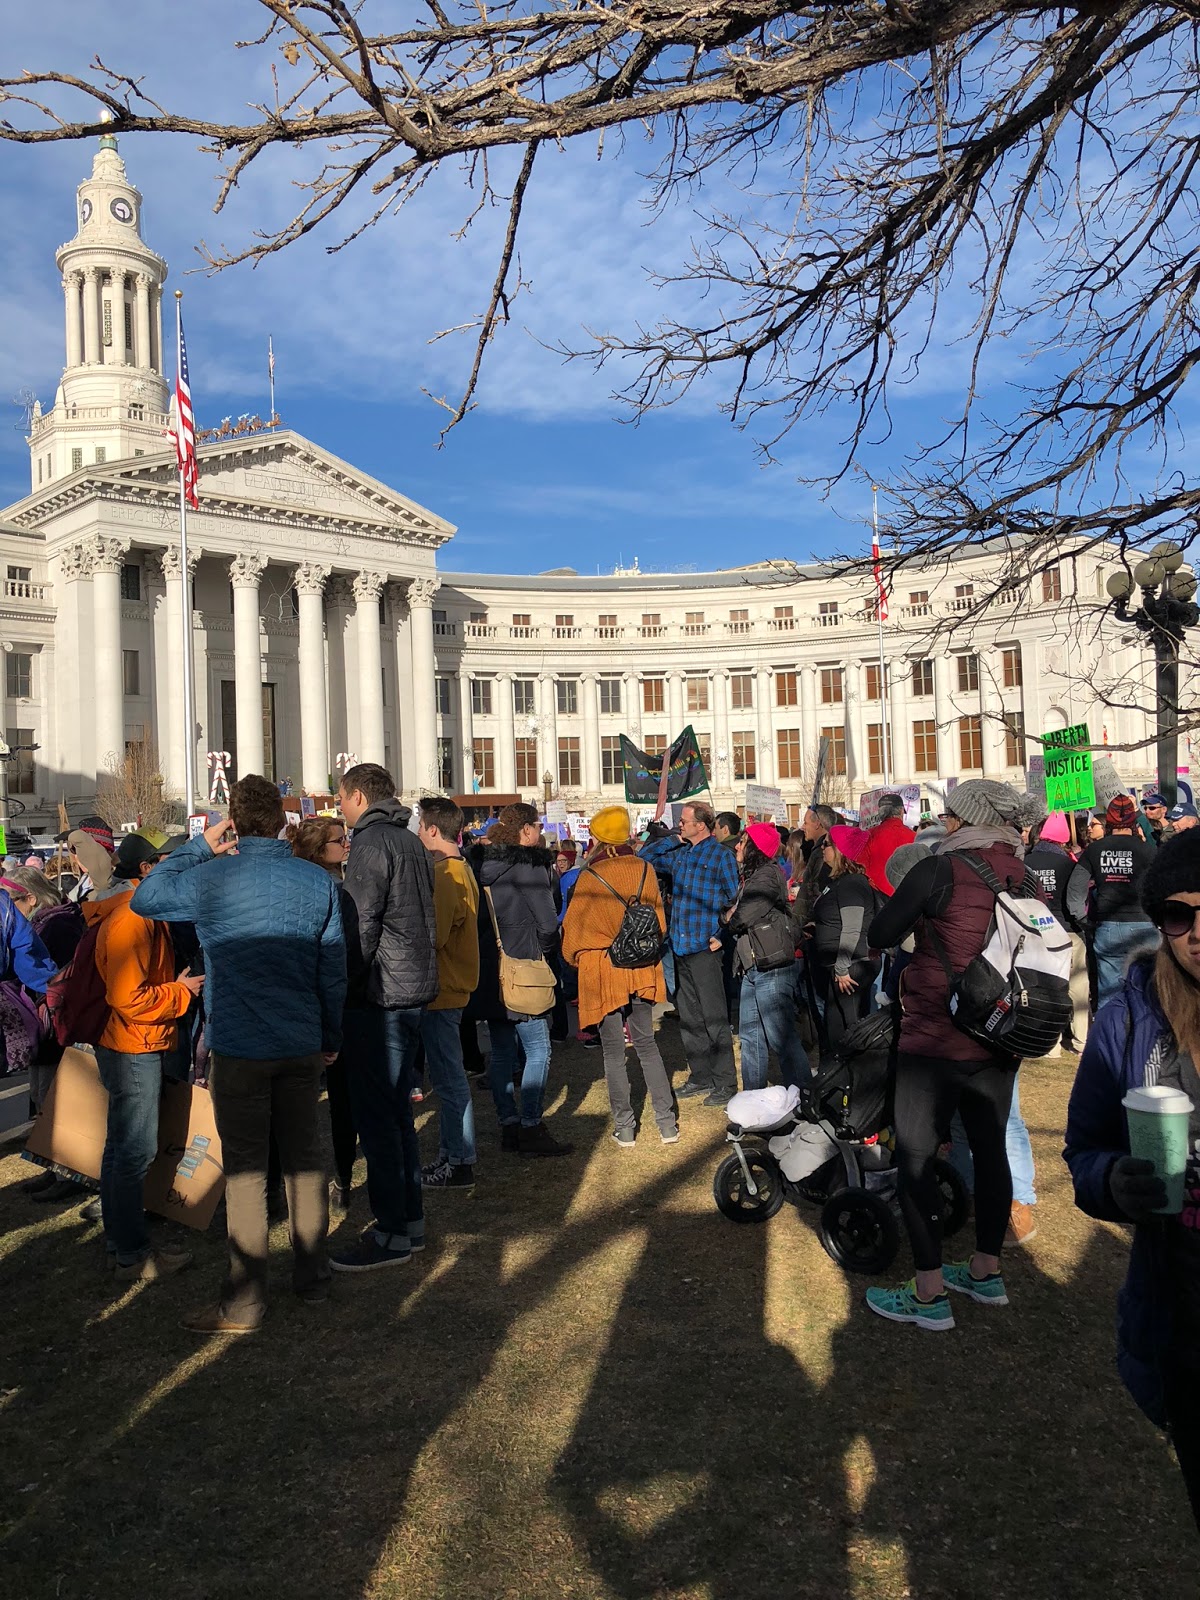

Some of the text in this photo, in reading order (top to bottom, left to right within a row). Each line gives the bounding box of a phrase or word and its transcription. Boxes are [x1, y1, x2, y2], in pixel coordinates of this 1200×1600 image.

[1043, 723, 1087, 751] LIBERTY
[1046, 754, 1089, 778] JUSTICE
[1054, 777, 1090, 810] ALL
[1100, 857, 1133, 867] LIVES
[1101, 850, 1133, 858] #QUEER
[1101, 866, 1133, 875] MATTER
